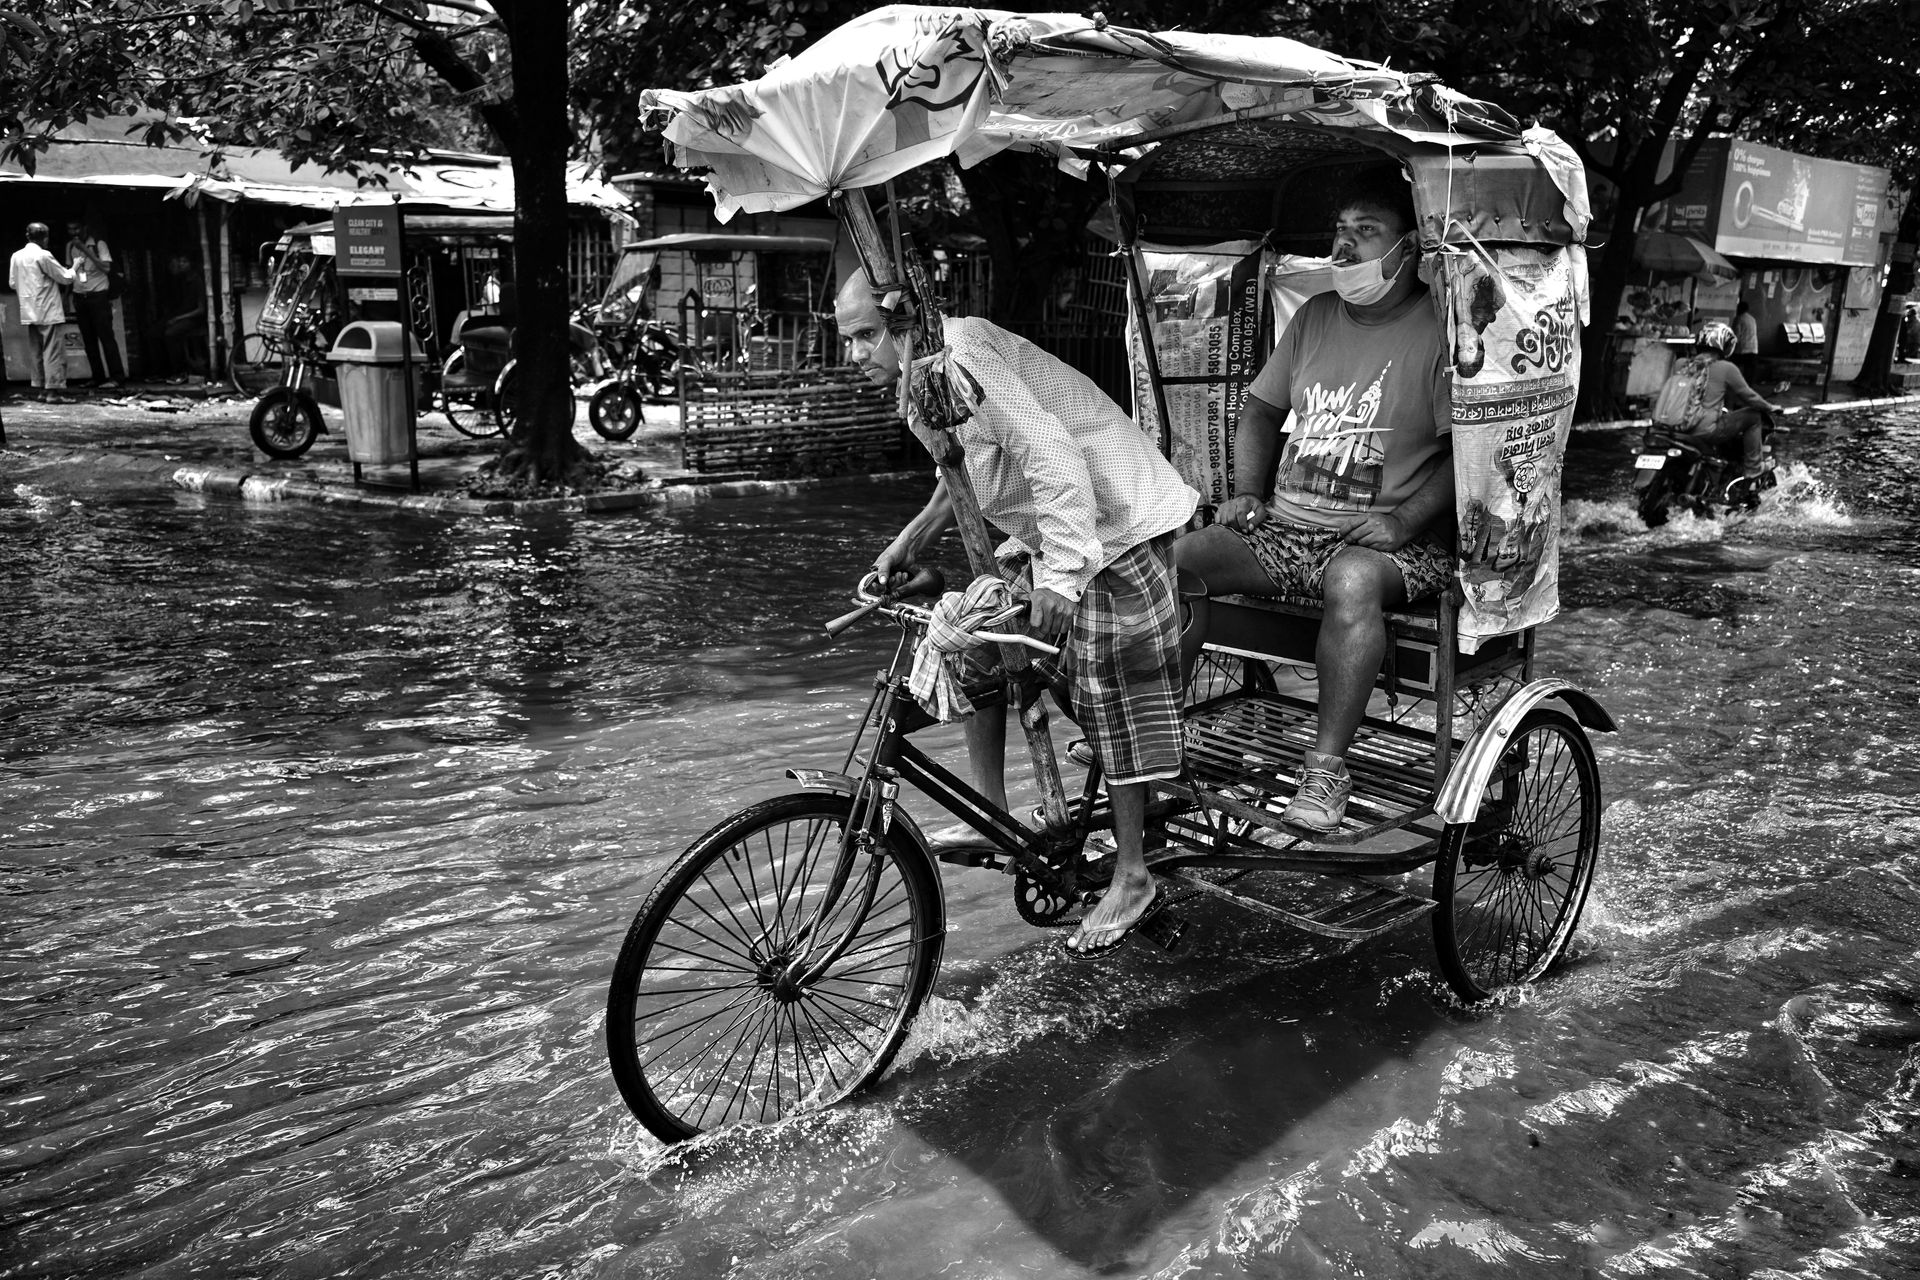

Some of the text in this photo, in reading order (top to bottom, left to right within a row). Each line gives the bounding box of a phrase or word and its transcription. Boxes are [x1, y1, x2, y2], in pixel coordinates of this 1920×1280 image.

[1734, 148, 1746, 162] 0%
[349, 246, 385, 255] ELEGANT
[1245, 278, 1257, 313] (W.B.)
[1229, 307, 1243, 361] Complex,
[1244, 316, 1255, 336] 052
[1207, 325, 1221, 395] 765803055
[1242, 339, 1252, 359] 700
[1226, 364, 1241, 410] Housng
[1299, 382, 1357, 415] New
[1484, 399, 1530, 420] বিধানসভা
[1501, 431, 1556, 460] বাংলা নিজের
[1504, 426, 1524, 442] চায়
